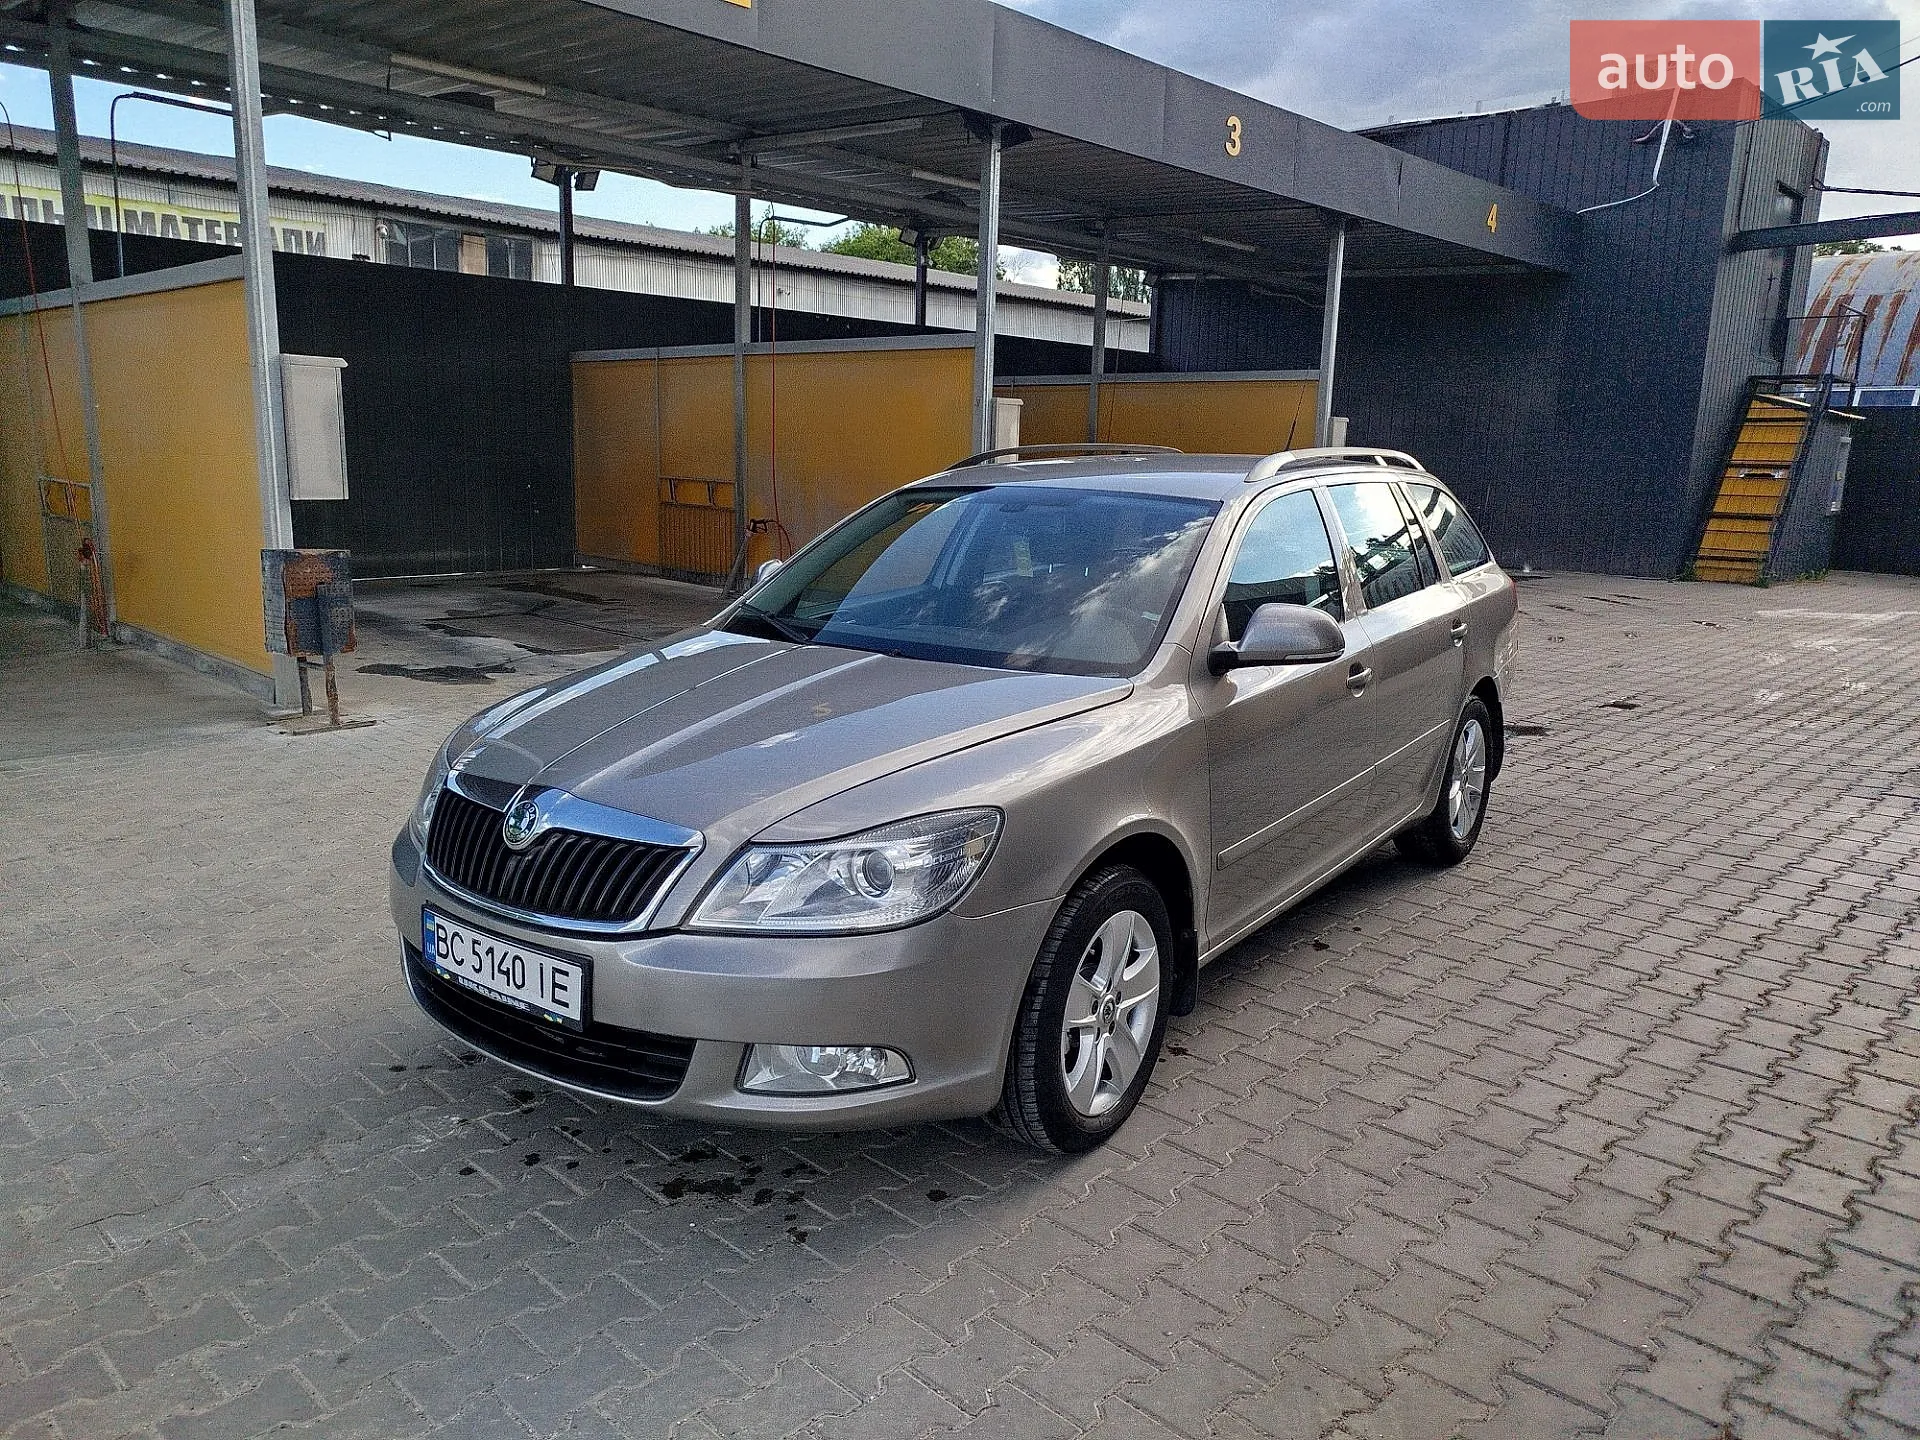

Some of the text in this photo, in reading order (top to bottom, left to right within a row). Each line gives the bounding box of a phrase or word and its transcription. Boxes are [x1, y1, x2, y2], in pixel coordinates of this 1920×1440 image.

[1225, 115, 1242, 157] 3
[1486, 204, 1498, 232] 4
[435, 923, 570, 1008] BC 5140 IE
